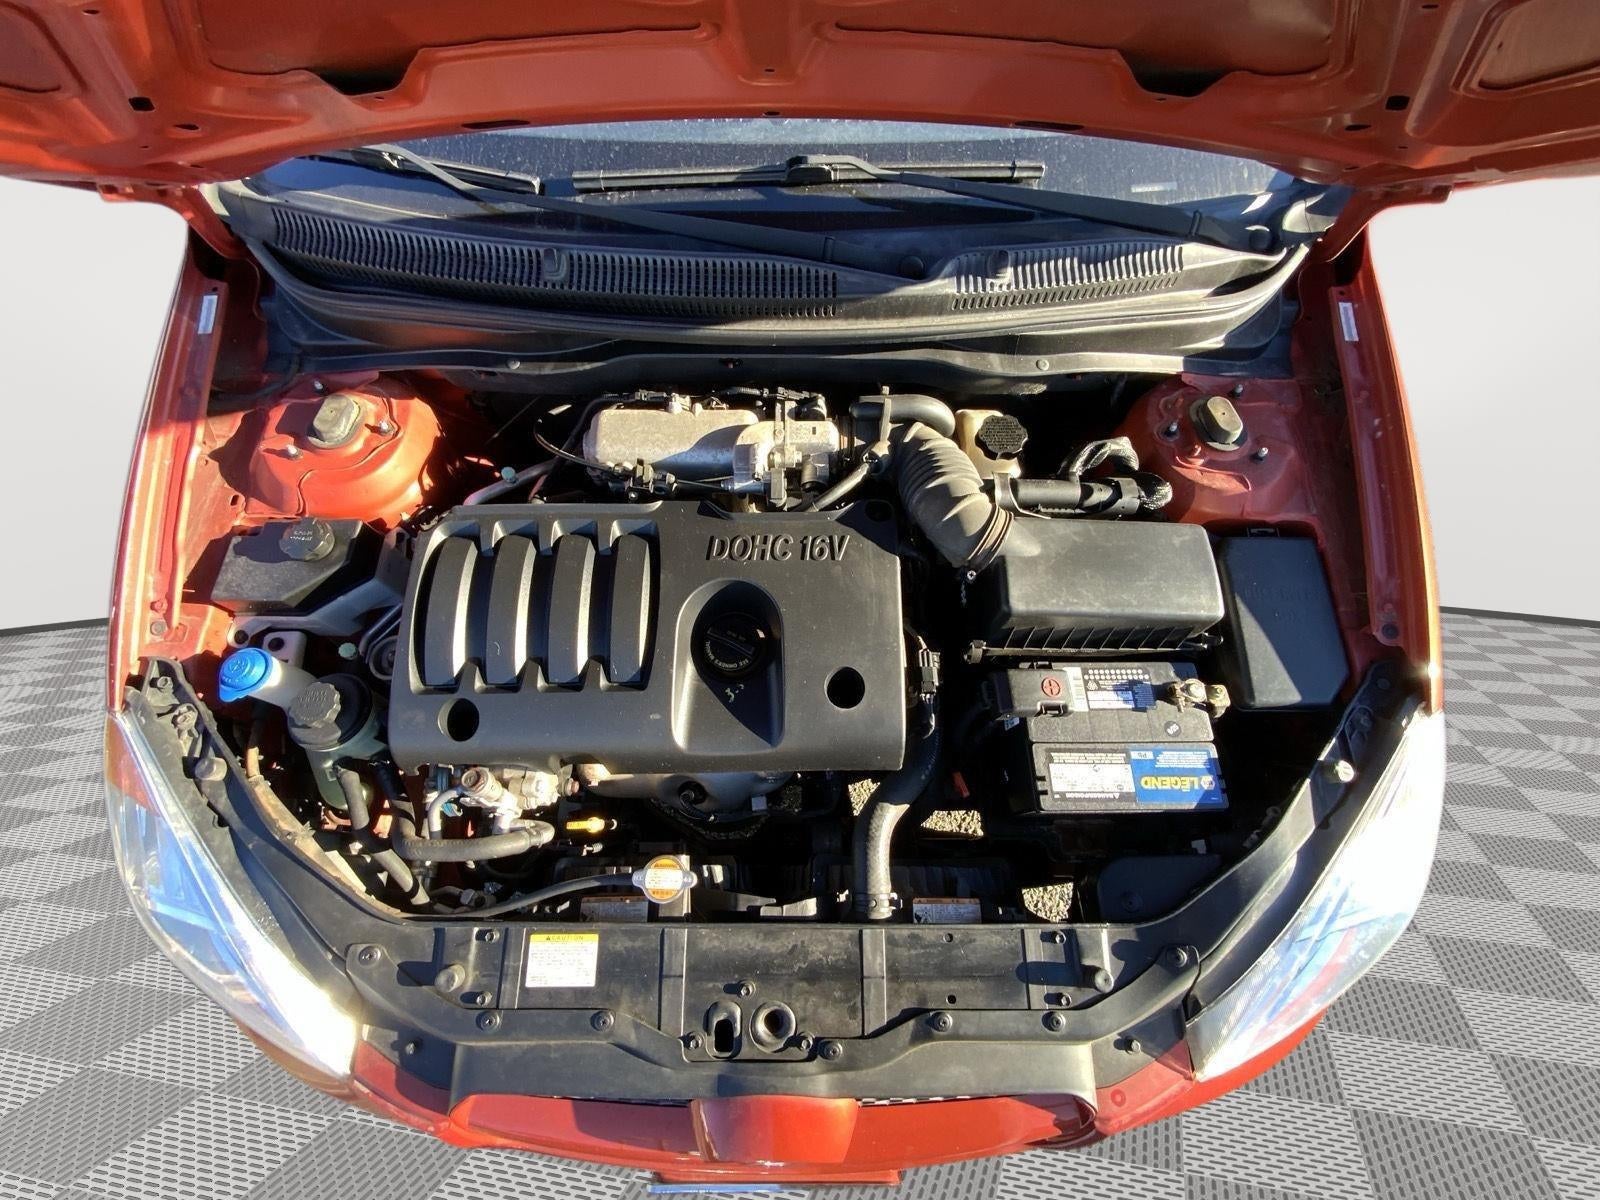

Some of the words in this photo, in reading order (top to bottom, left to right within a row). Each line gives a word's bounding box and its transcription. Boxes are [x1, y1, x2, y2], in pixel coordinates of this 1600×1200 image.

[706, 533, 794, 561] DOHC
[800, 534, 850, 561] 16V
[1141, 776, 1199, 790] LEGEND
